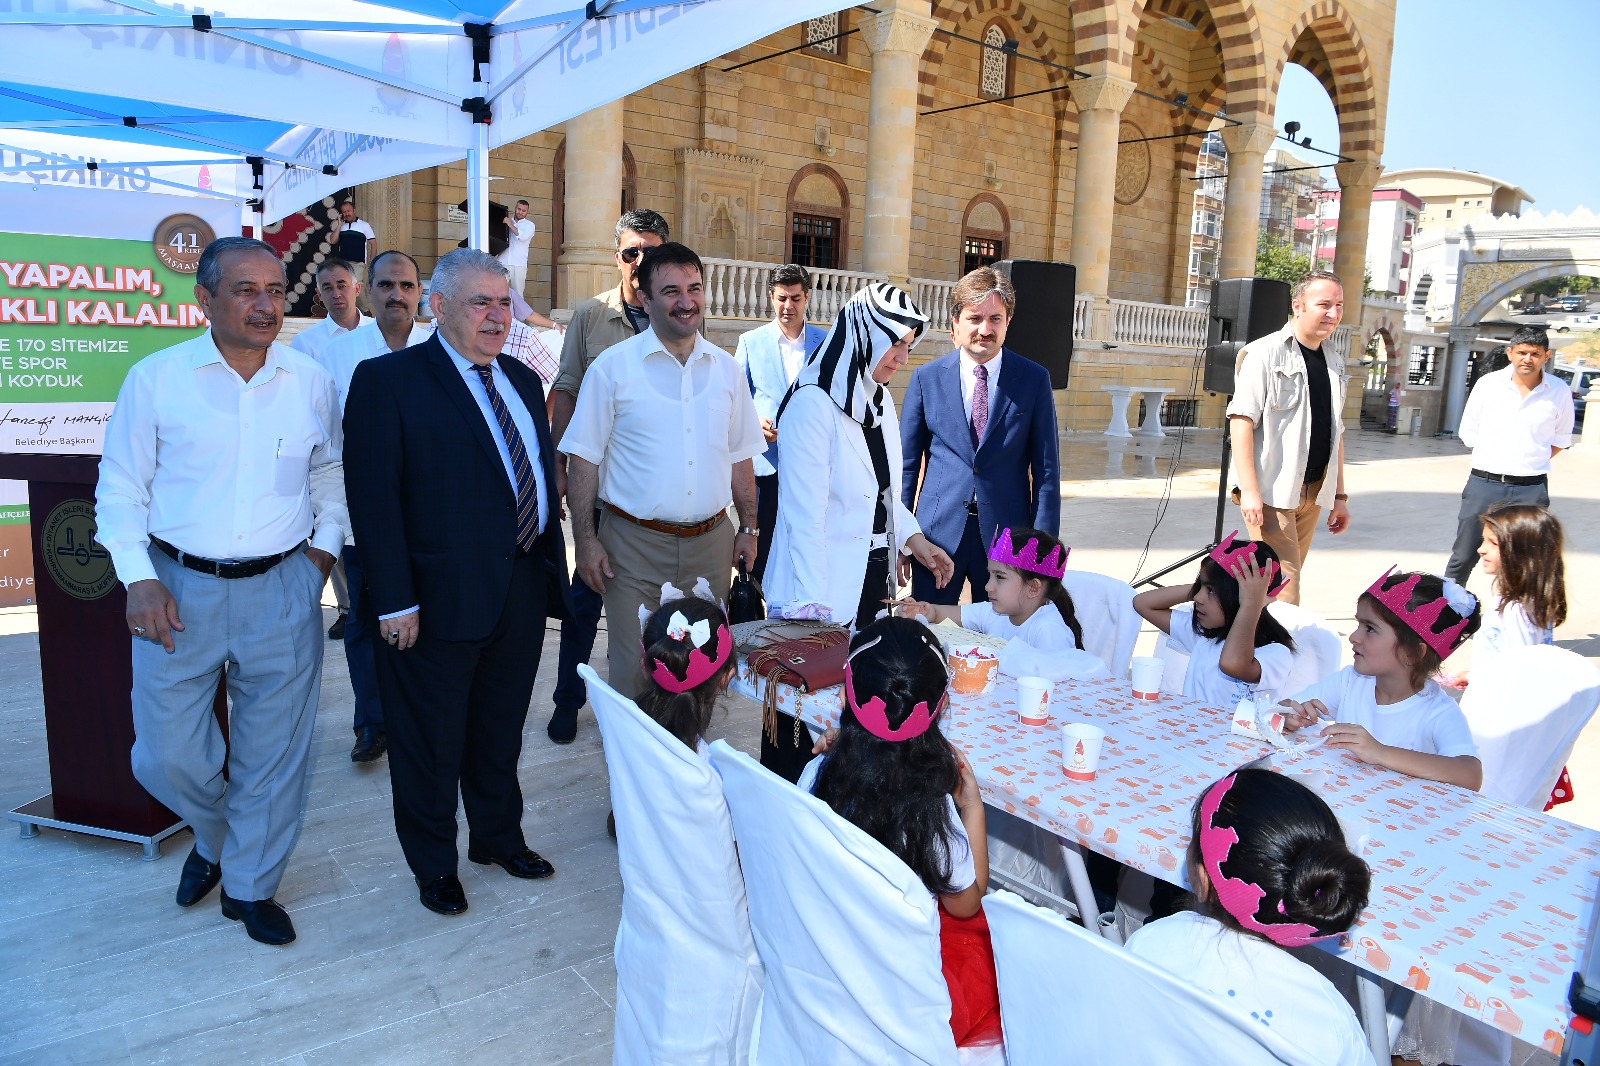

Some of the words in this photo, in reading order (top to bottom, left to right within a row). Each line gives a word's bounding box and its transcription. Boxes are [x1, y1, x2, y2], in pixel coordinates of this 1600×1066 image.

[169, 232, 200, 254] 41
[0, 262, 162, 296] YAPALIM,
[16, 339, 46, 352] 170
[50, 338, 129, 353] SİTEMİZE
[18, 357, 67, 370] SPOR
[8, 374, 84, 387] KOYDUK
[59, 436, 95, 446] Başkanı
[62, 505, 84, 516] İŞLERİ
[46, 549, 91, 594] KAHRAMANMARAŞ
